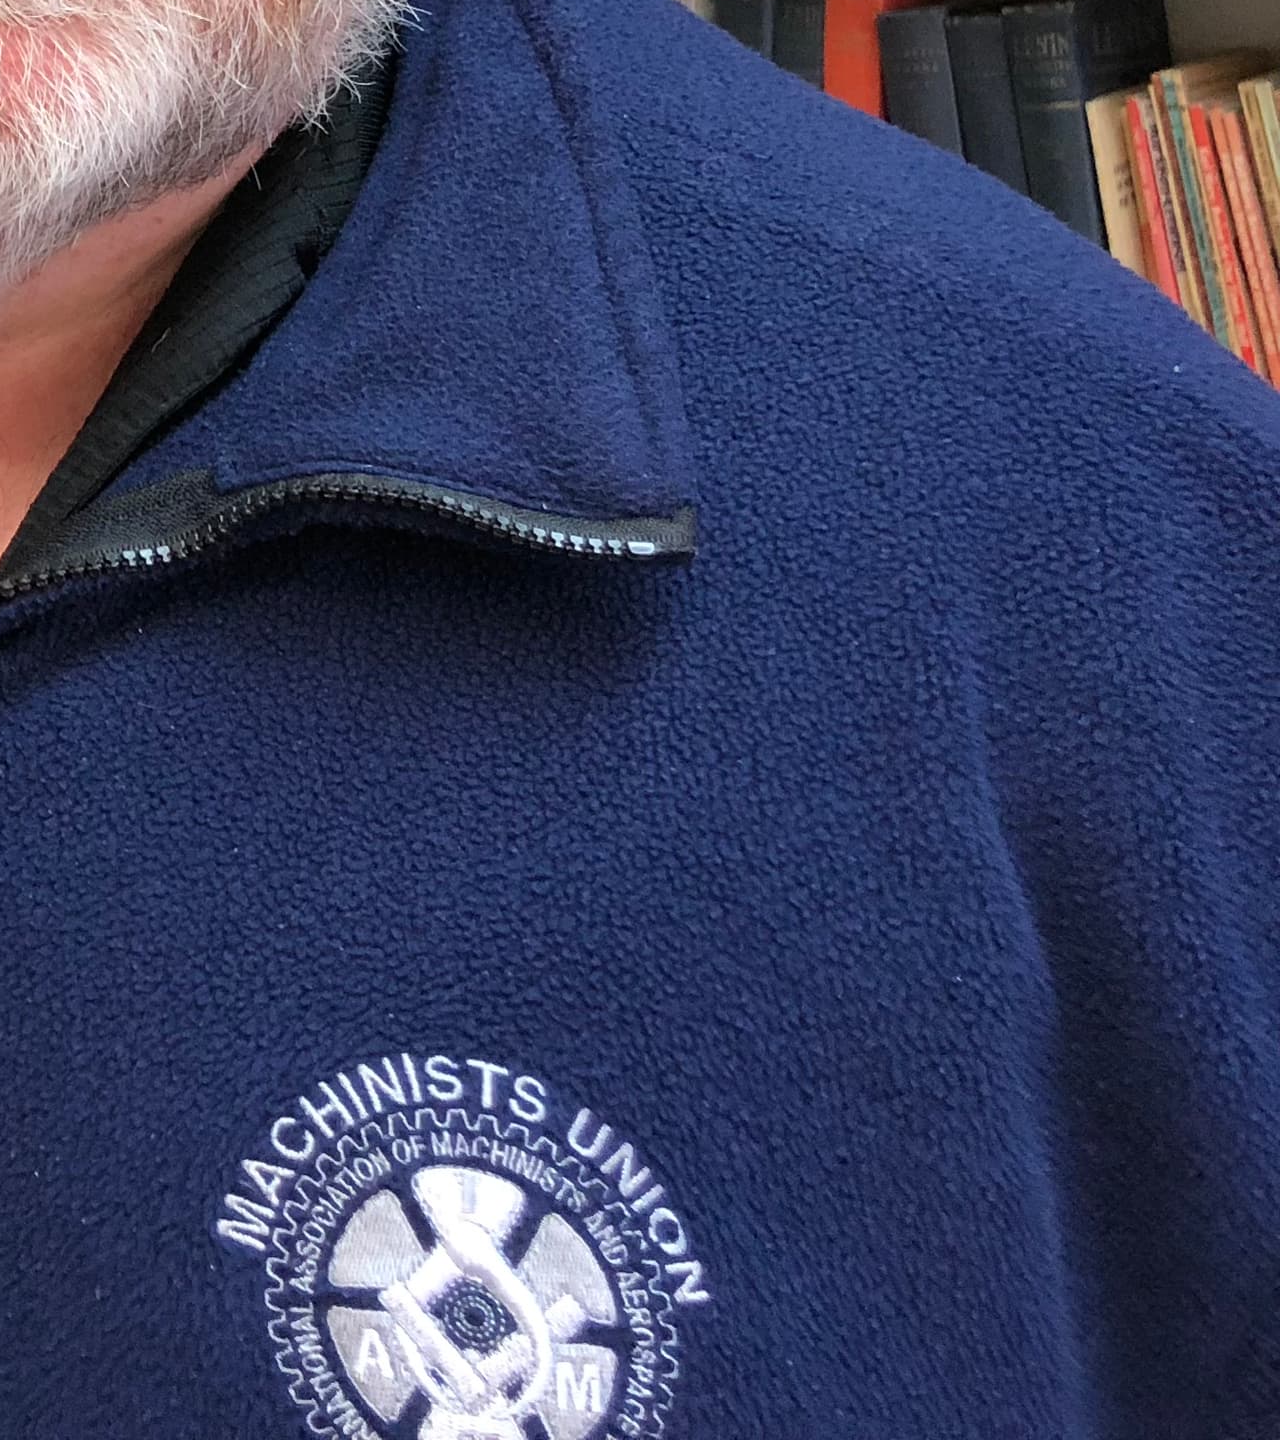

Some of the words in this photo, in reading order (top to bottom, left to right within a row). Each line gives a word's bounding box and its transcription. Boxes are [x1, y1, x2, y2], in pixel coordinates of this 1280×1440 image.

[391, 1133, 427, 1166] OF
[216, 1053, 548, 1252] MACHINISTS
[567, 1107, 712, 1304] UNION
[353, 1327, 394, 1384] A
[555, 1360, 603, 1411] M
